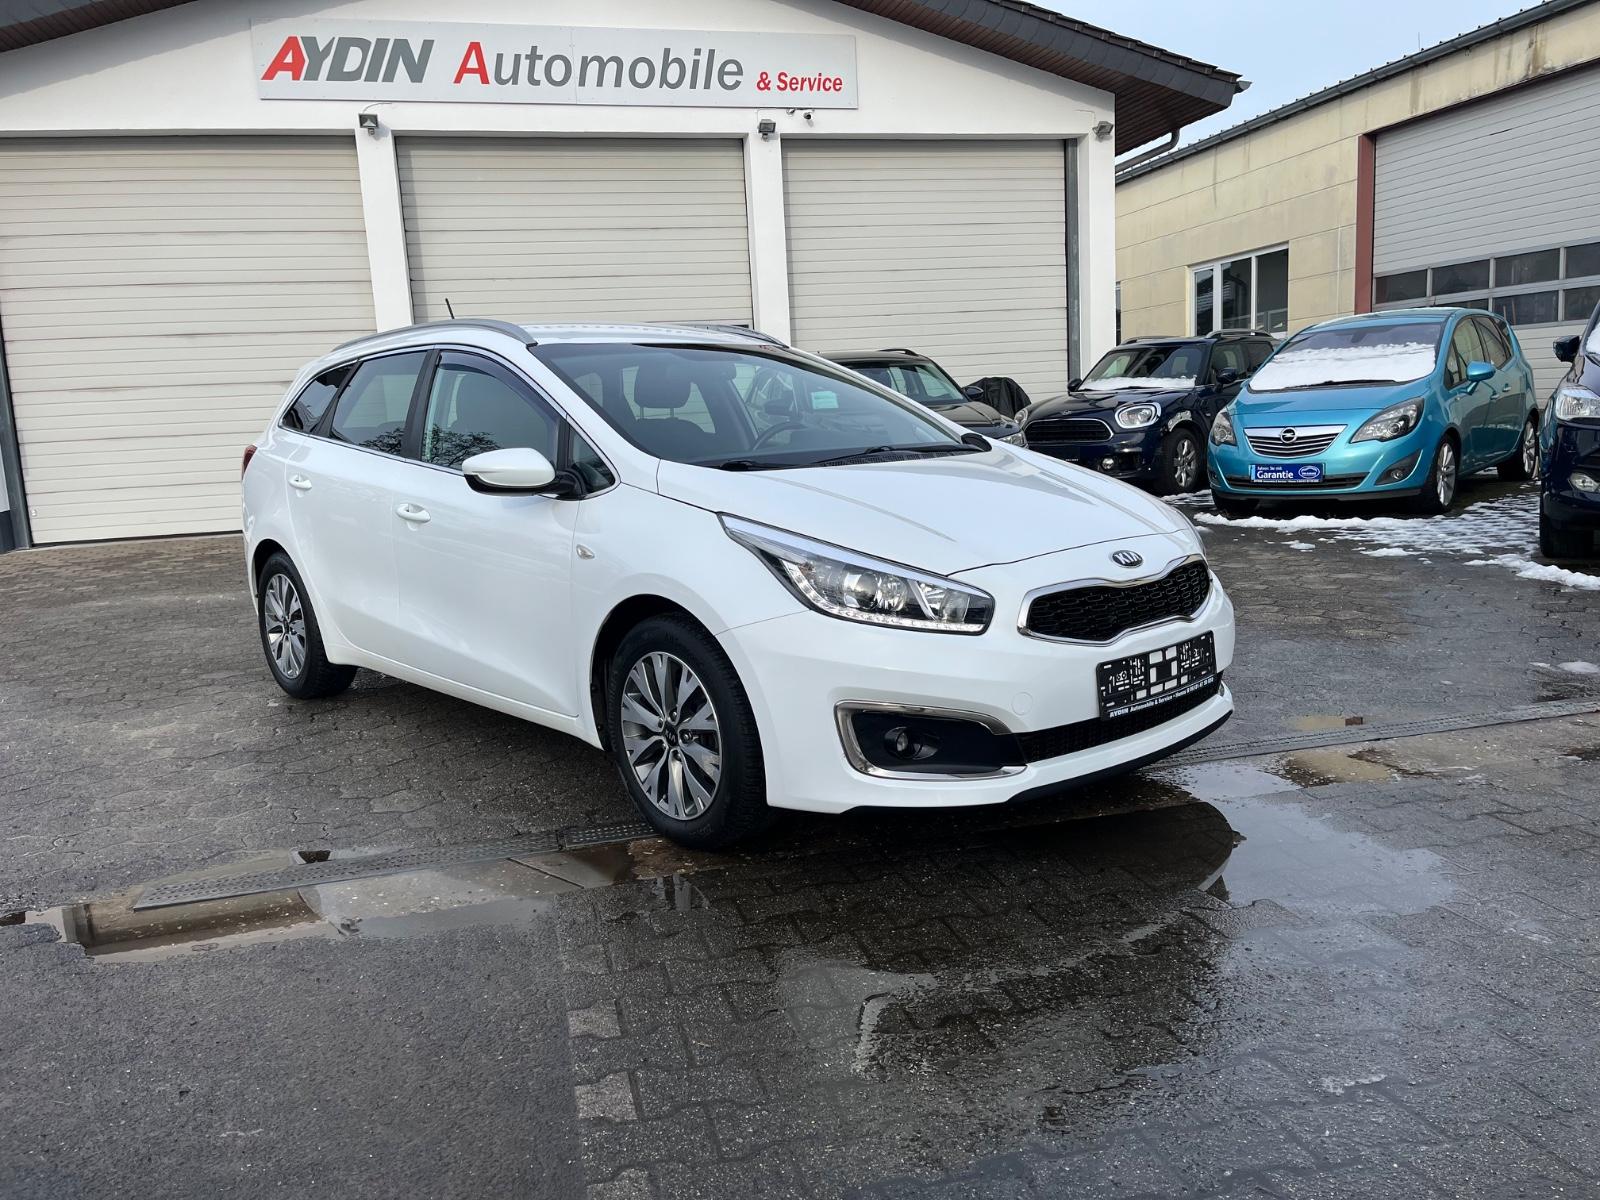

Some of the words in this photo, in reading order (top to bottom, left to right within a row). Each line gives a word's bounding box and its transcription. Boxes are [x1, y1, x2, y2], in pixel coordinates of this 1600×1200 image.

[261, 36, 435, 83] AYDIN
[453, 41, 744, 91] Automobile
[756, 71, 771, 91] &
[777, 71, 843, 92] Service
[1257, 470, 1294, 479] Garantie
[1114, 552, 1141, 564] KIA
